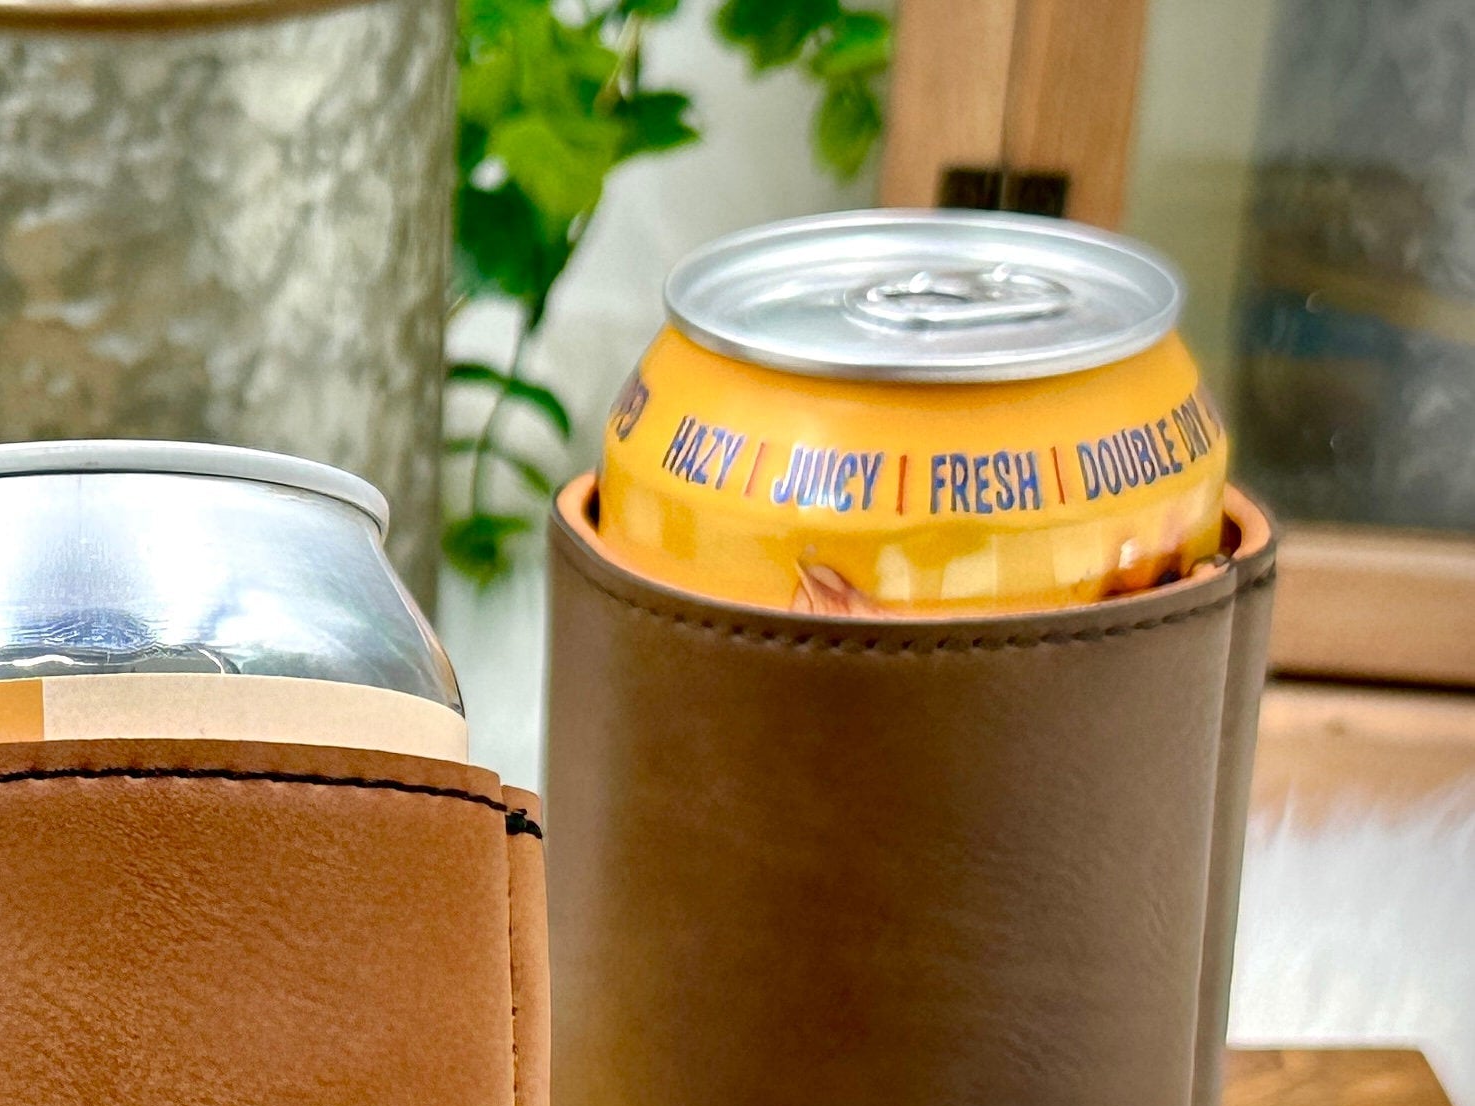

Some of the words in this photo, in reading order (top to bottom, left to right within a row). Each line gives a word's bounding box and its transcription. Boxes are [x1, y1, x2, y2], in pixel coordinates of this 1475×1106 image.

[662, 414, 746, 491] HAZY
[772, 446, 886, 513] JUICY
[929, 450, 1041, 515] FRESH
[1075, 418, 1183, 502] DOUBLE
